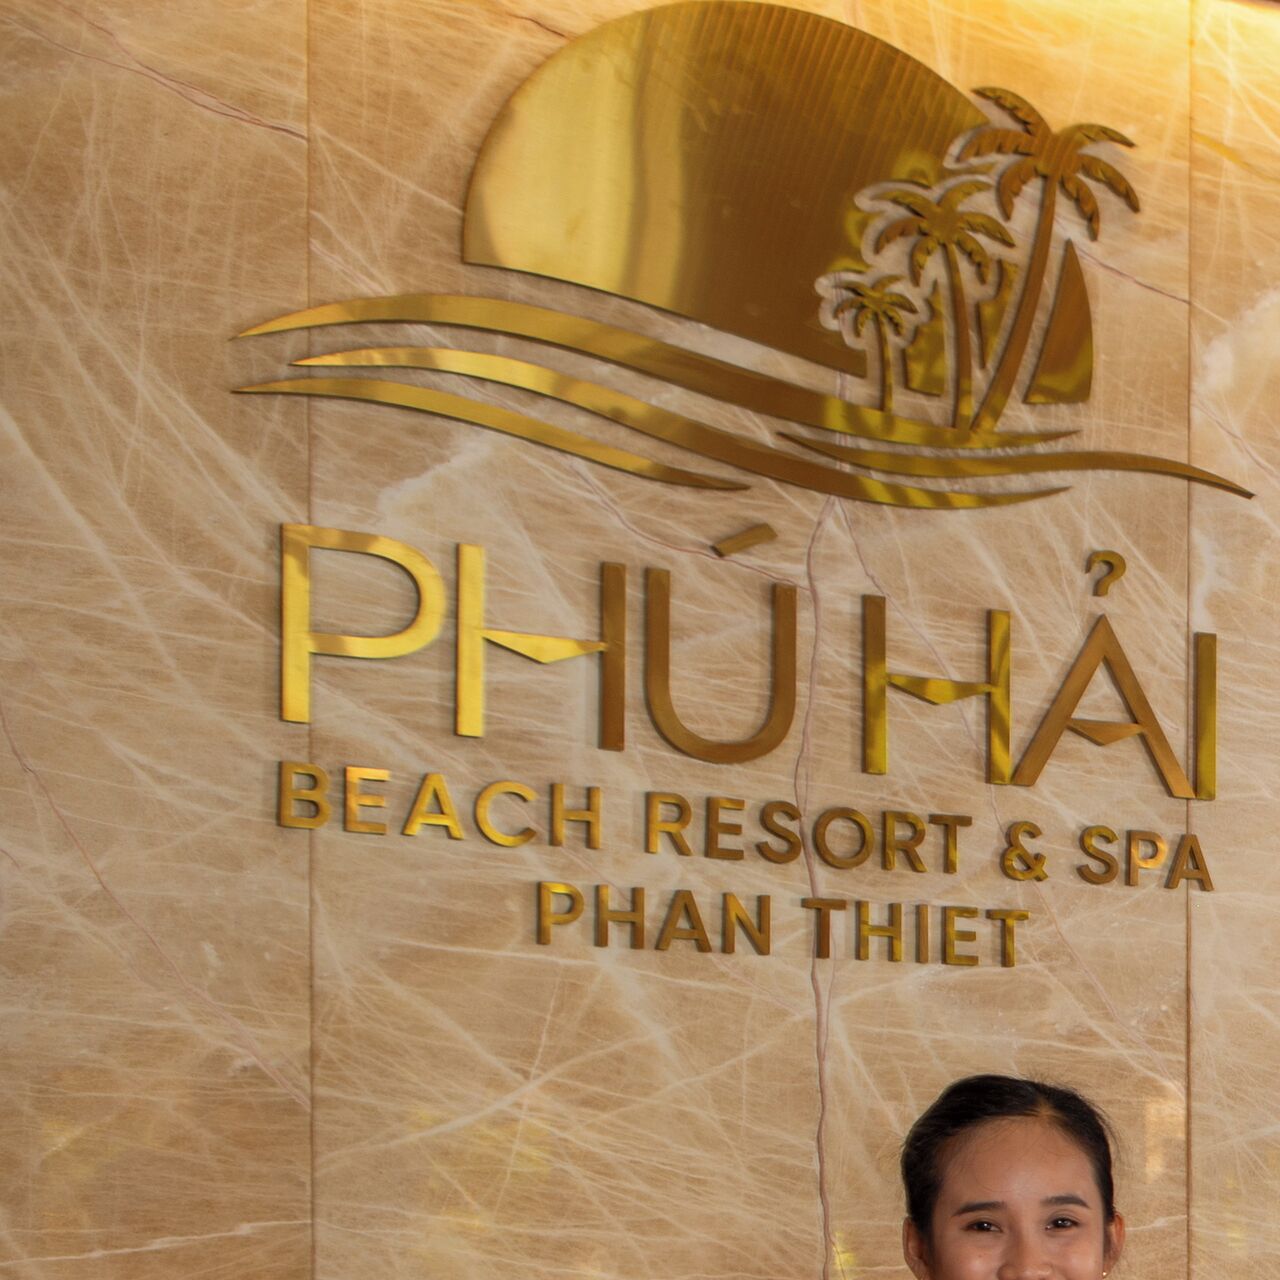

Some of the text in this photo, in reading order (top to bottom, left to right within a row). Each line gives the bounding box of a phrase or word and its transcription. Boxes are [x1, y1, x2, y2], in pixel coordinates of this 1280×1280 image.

[281, 522, 1217, 801] PHÚ HẢI
[278, 760, 1216, 892] BEACH RESORT & SPA
[538, 880, 1031, 967] PHAN THIET
